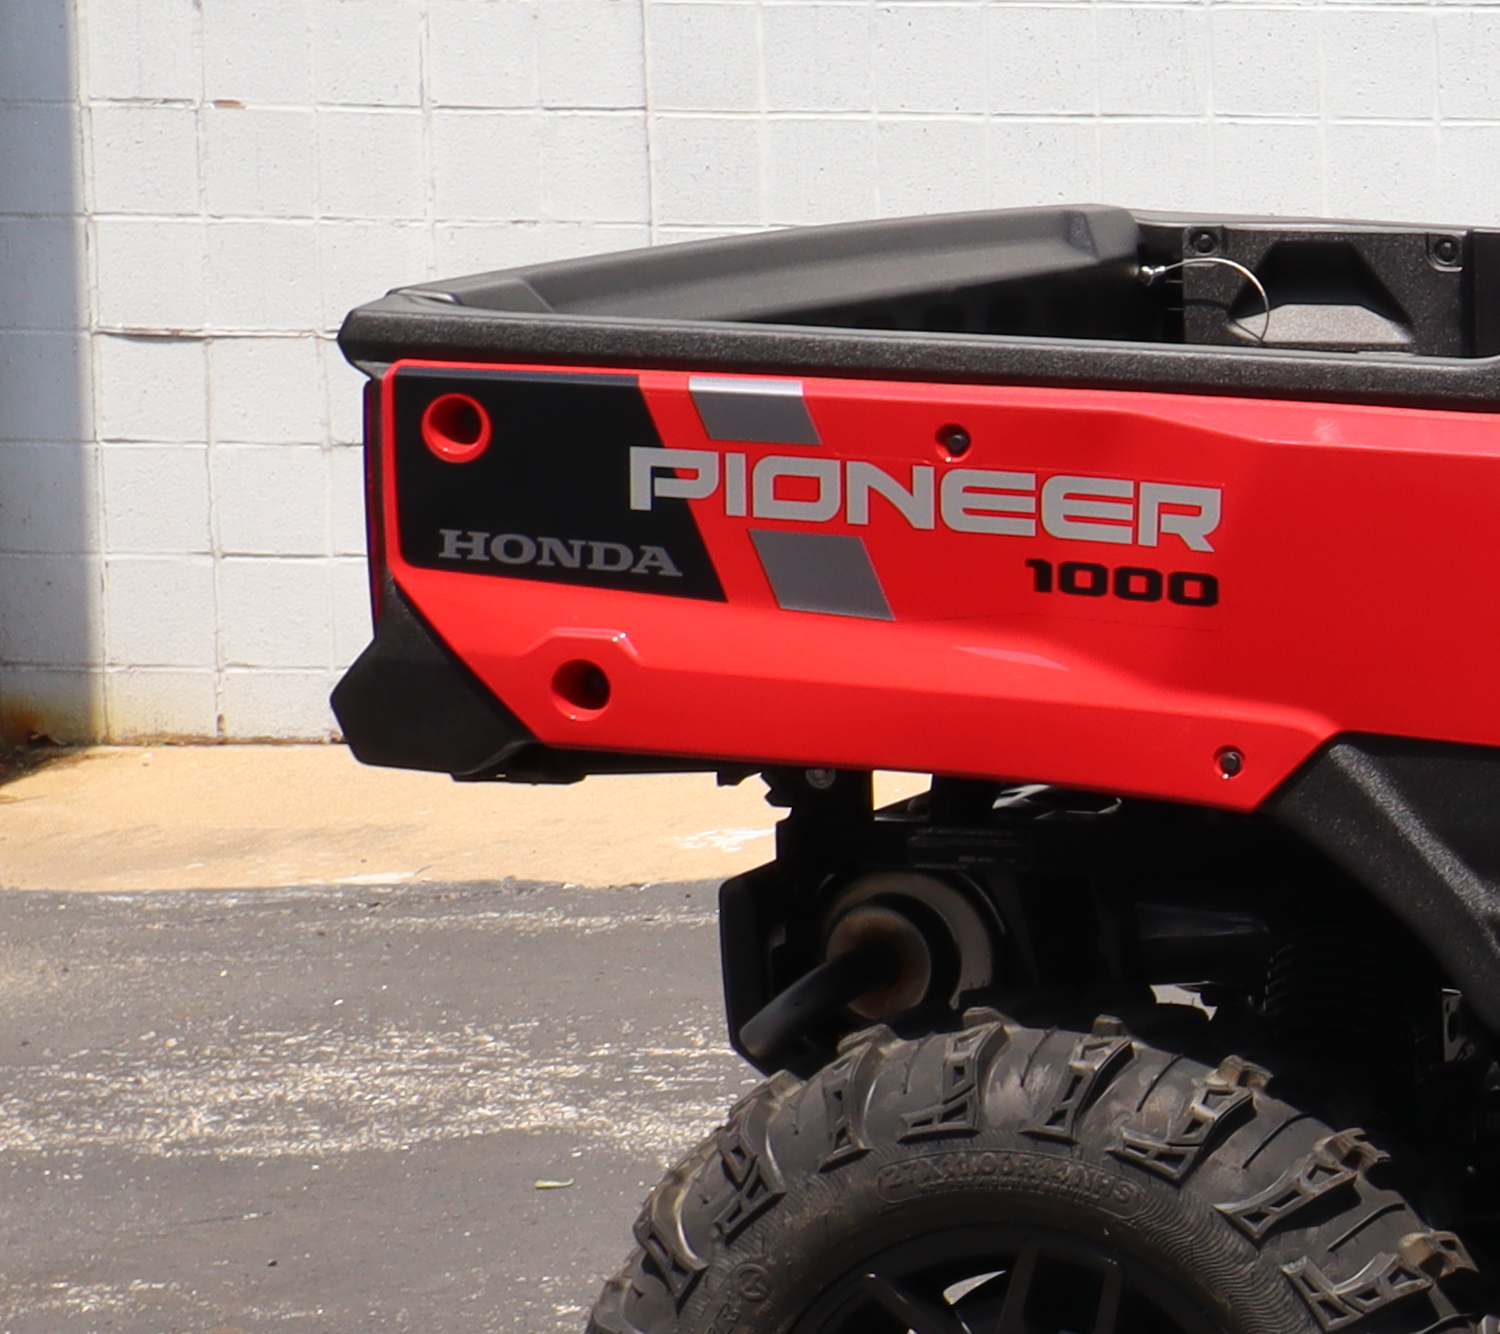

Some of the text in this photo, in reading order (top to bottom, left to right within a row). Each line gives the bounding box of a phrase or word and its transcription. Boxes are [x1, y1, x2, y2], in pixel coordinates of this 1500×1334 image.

[629, 445, 1222, 553] PIONEER
[438, 527, 683, 577] HONDA
[1024, 557, 1220, 607] 1000
